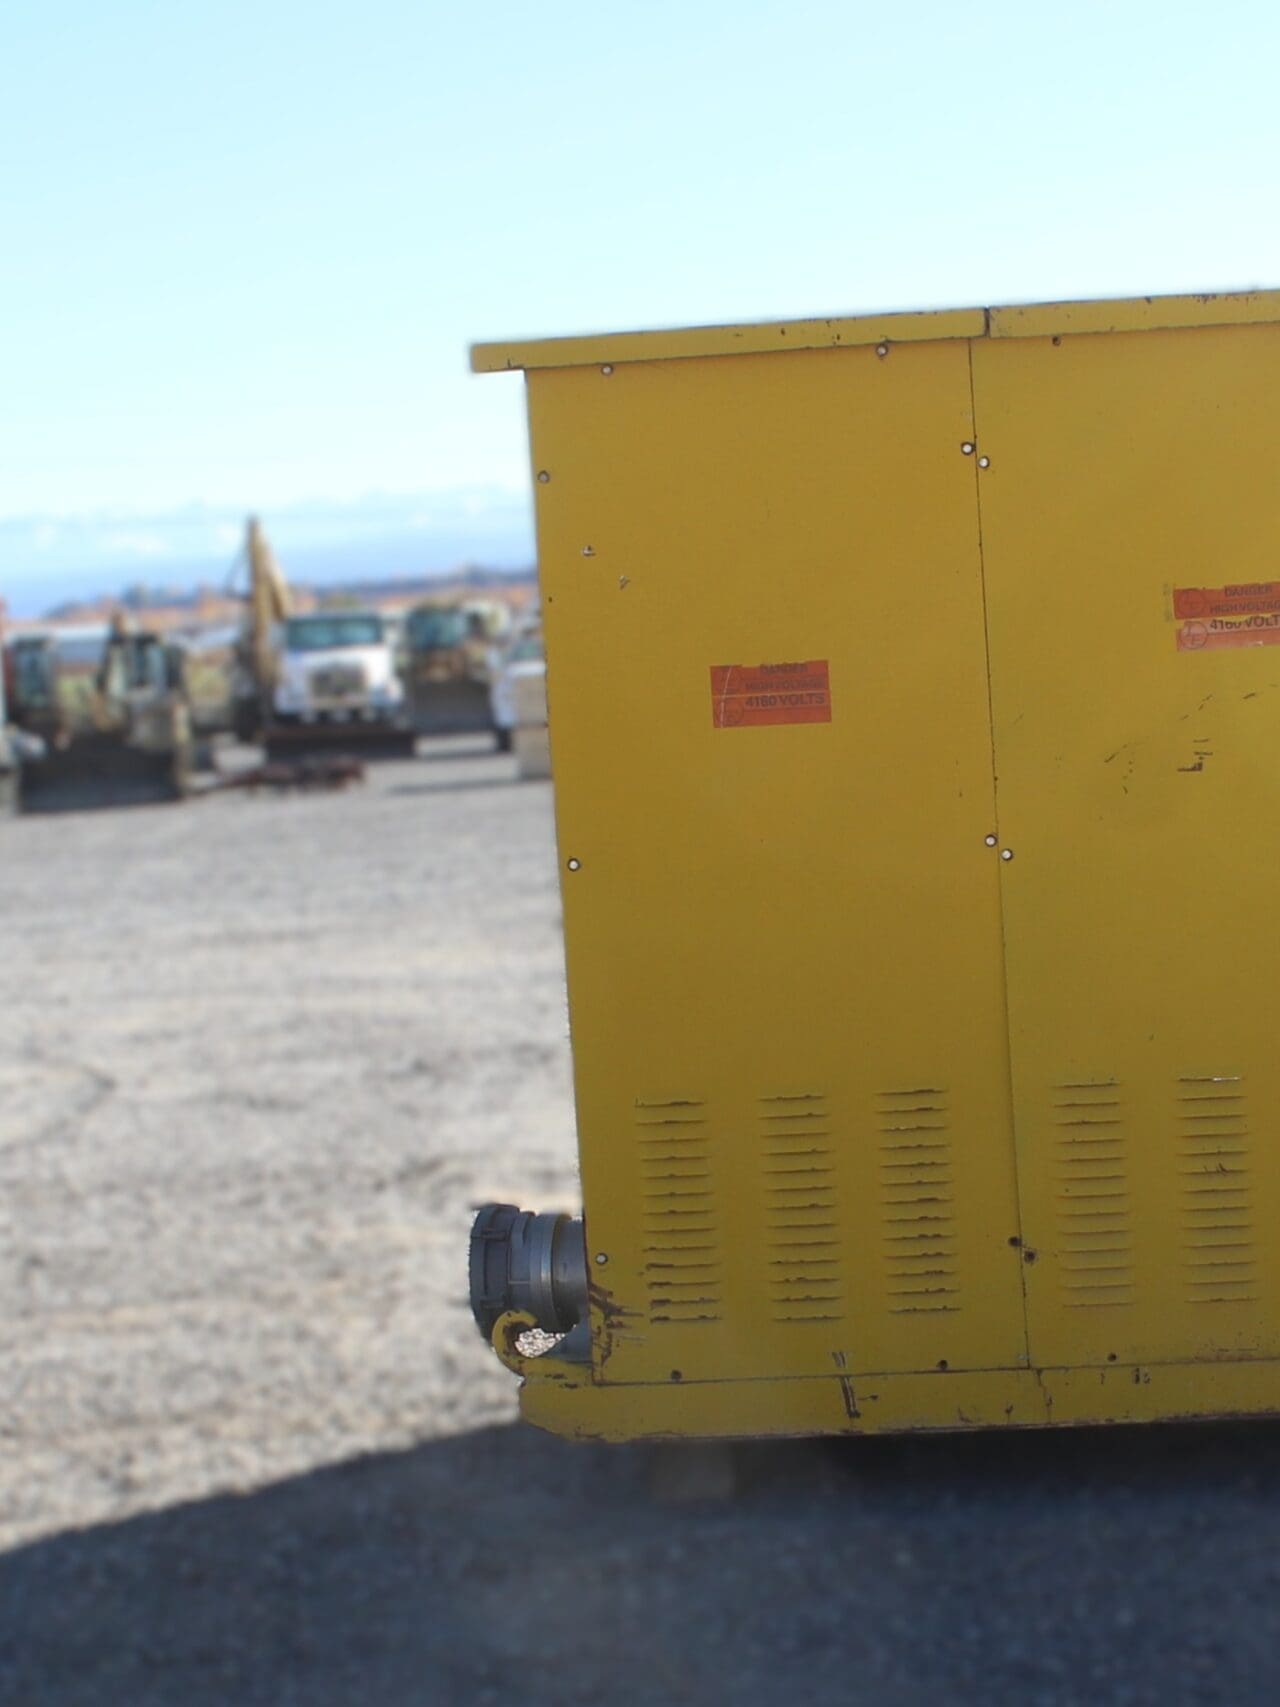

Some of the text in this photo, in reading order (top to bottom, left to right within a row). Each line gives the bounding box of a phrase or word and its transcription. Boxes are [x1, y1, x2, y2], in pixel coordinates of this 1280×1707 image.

[1224, 584, 1273, 597] DANGER
[1210, 603, 1238, 614] HIGH
[1210, 618, 1242, 631] 4160
[745, 693, 825, 707] 4160 VOLTS
